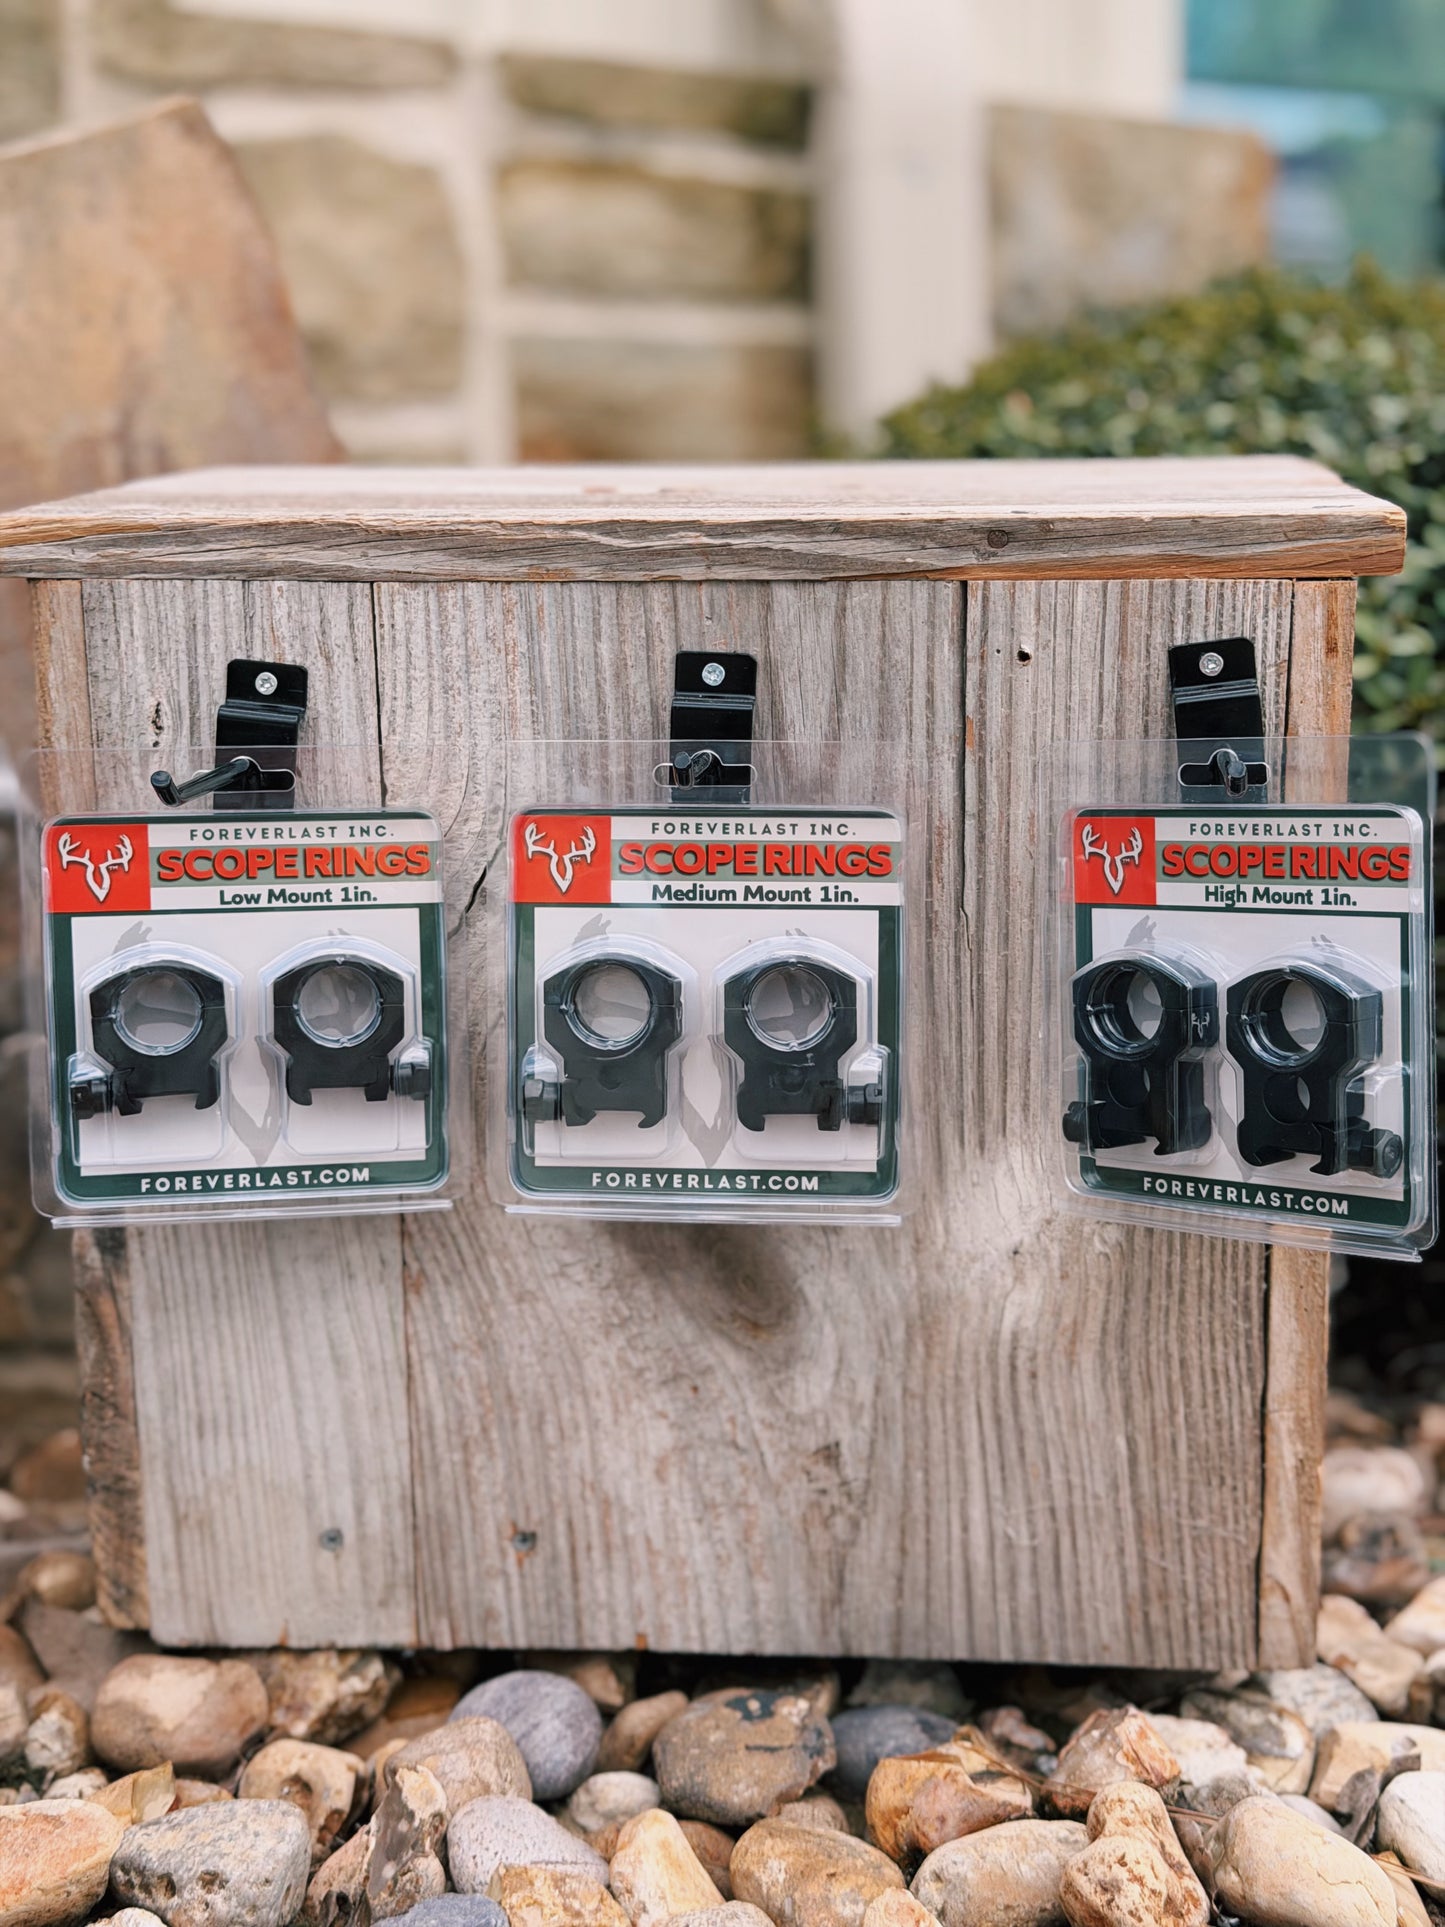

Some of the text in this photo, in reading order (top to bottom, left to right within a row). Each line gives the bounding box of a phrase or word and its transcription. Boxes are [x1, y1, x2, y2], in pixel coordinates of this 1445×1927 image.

[189, 825, 396, 841] FOREVERLAST INC.
[651, 822, 857, 836] FOREVERLAST INC.
[1189, 823, 1379, 837] FOREVERLAST INC.
[157, 844, 432, 881] SCOPE RINGS
[618, 843, 893, 877] SCOPE RINGS
[1161, 843, 1414, 881] SCOPE RINGS
[219, 886, 378, 906] Low Mount 1in.
[651, 883, 860, 903] Medium Mount 1in.
[1204, 885, 1358, 908] High Mount 1in.
[140, 1168, 370, 1193] FOREVERLAST.COM
[592, 1172, 819, 1191] FOREVERLAST.COM
[1143, 1177, 1348, 1215] FOREVERLAST.COM
